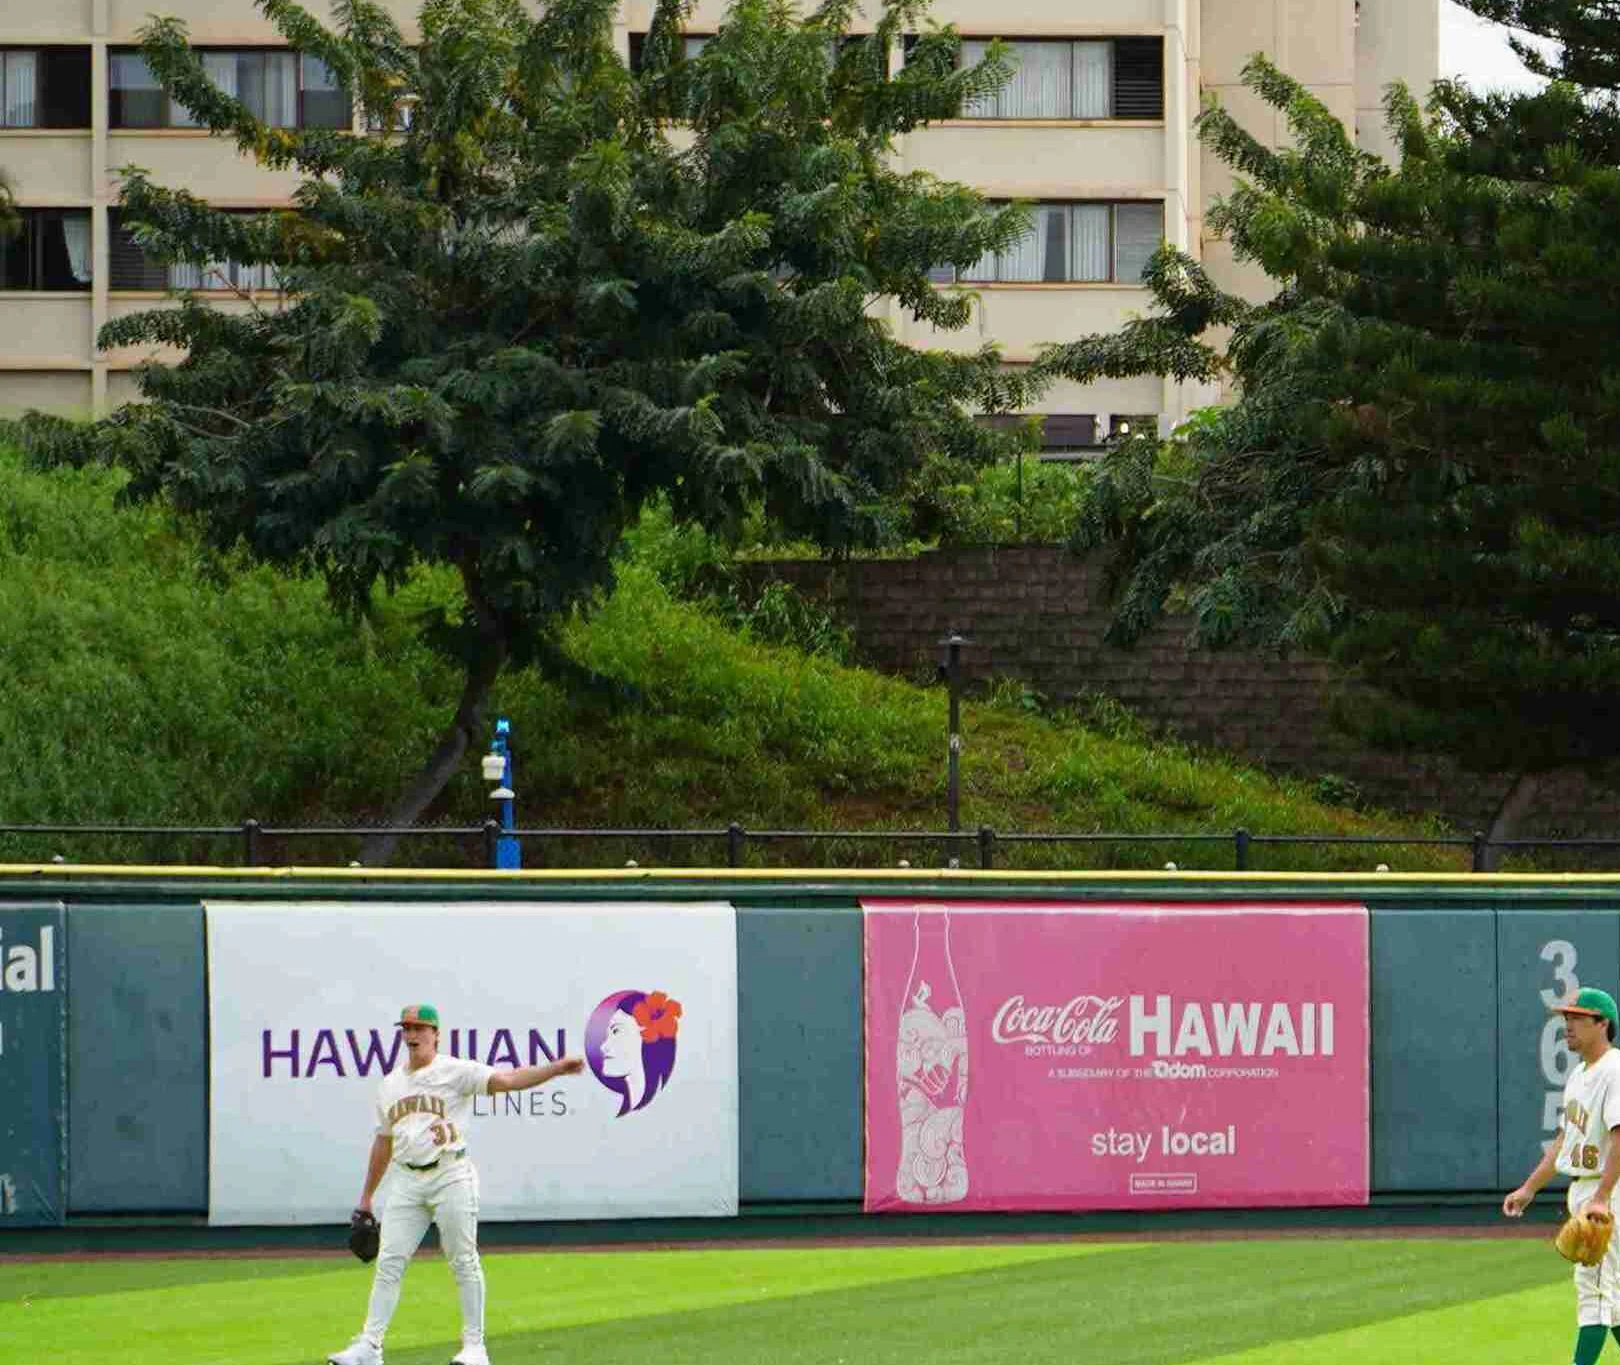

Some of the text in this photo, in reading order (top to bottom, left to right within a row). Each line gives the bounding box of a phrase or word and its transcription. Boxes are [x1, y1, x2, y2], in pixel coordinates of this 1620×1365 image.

[0, 926, 55, 991] al
[991, 994, 1335, 1057] Coca-Cola HAWAII
[262, 1028, 566, 1079] HAWIIAN
[473, 1090, 567, 1117] LINES
[1092, 1125, 1237, 1163] stay local
